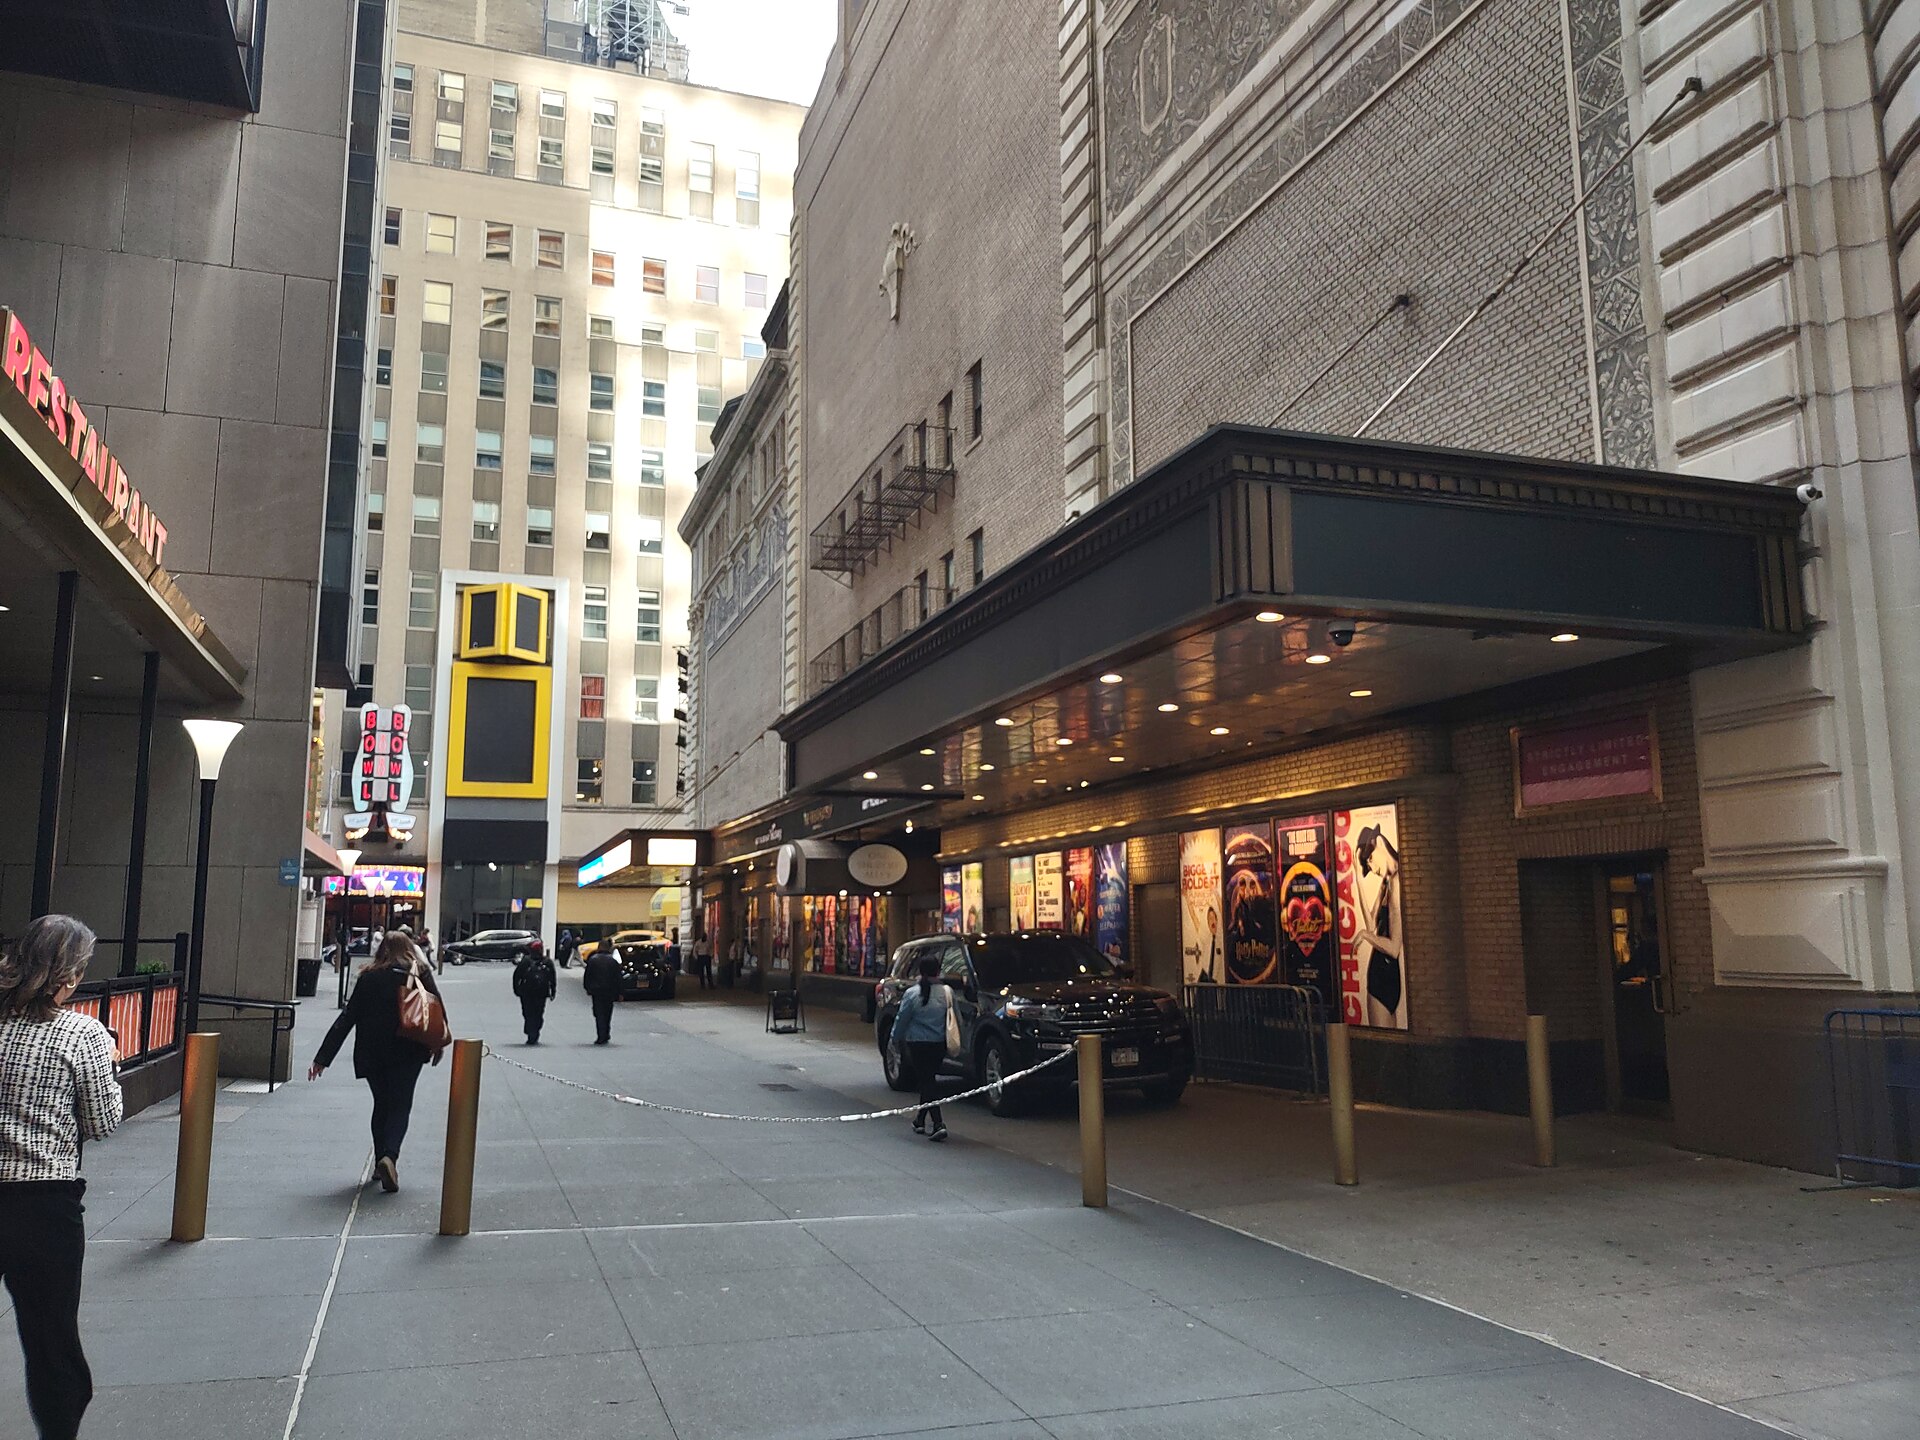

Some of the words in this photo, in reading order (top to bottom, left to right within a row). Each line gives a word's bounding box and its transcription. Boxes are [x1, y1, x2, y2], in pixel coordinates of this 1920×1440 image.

[4, 310, 168, 566] RESTAURANT
[361, 710, 377, 800] BOWL
[389, 711, 404, 801] BOWL
[1527, 744, 1584, 762] STRICTLY
[1591, 734, 1643, 752] LIMITED
[1541, 754, 1628, 776] ENGAGEMENT
[1183, 862, 1218, 877] BIGGET
[1334, 810, 1362, 1025] CHICAGO
